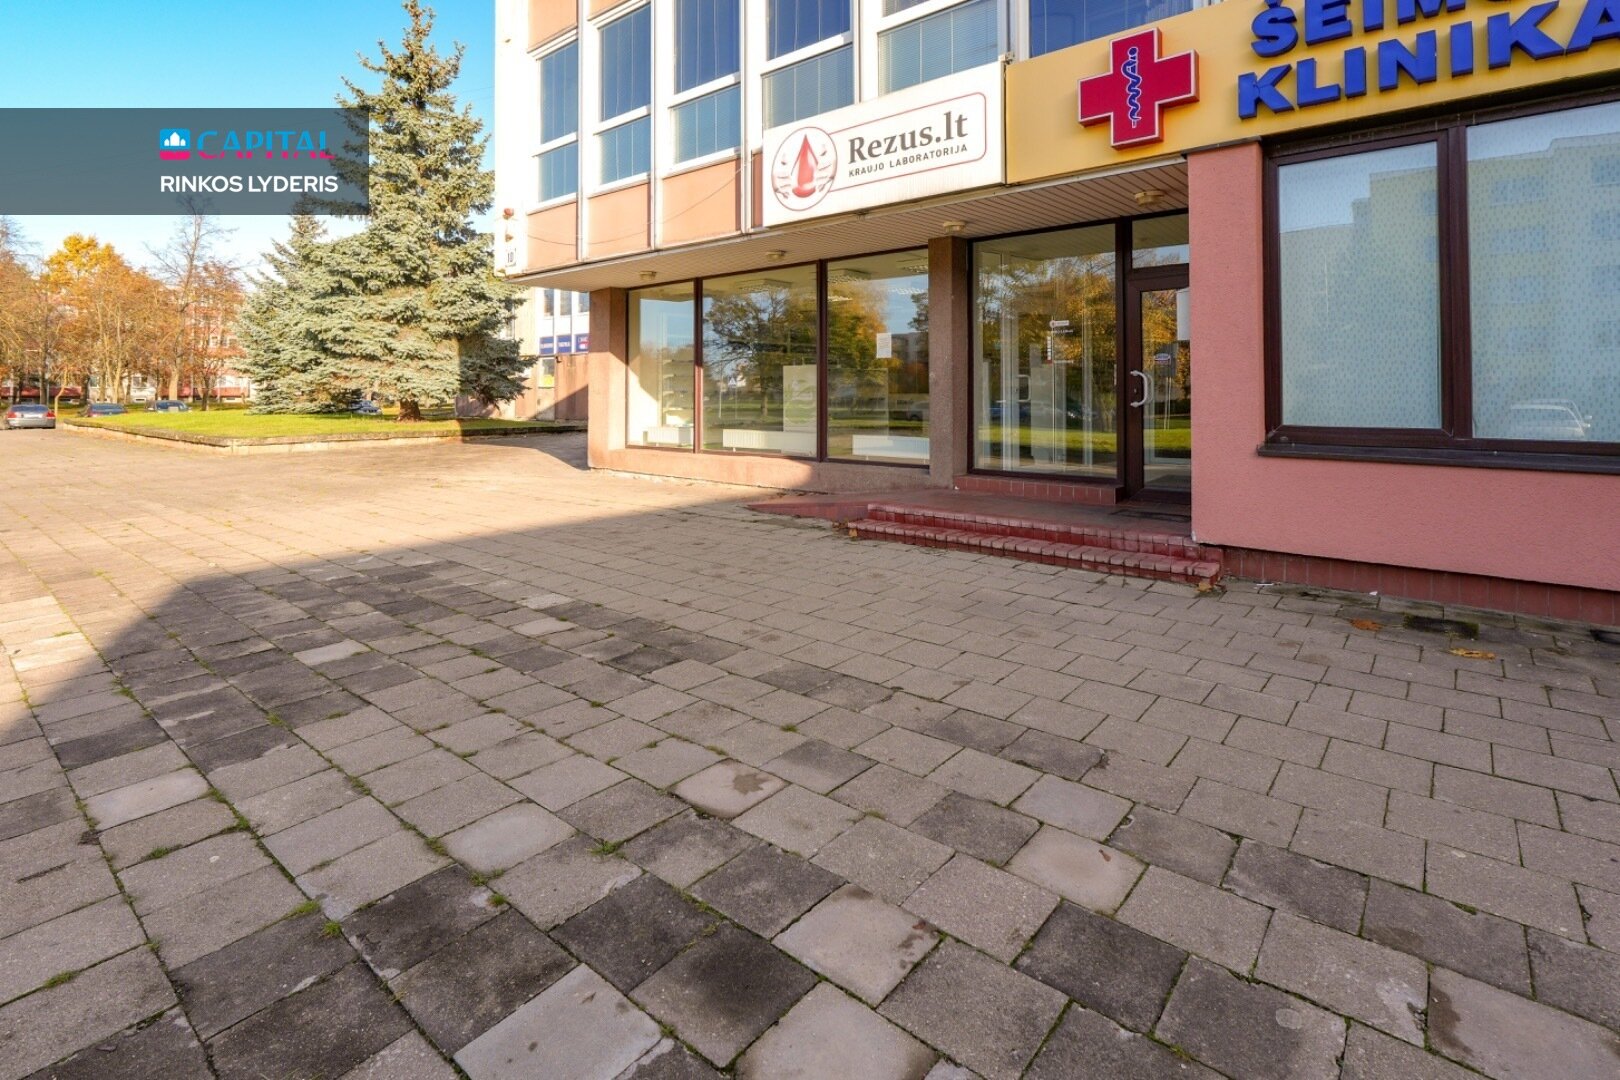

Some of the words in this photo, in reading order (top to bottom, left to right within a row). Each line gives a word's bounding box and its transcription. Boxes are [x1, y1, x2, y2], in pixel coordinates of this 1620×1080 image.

[1238, 0, 1620, 120] KLINIKA
[848, 111, 968, 164] Rezus.lt
[849, 163, 885, 177] KRAUJO
[889, 143, 968, 168] LABORATORIJA
